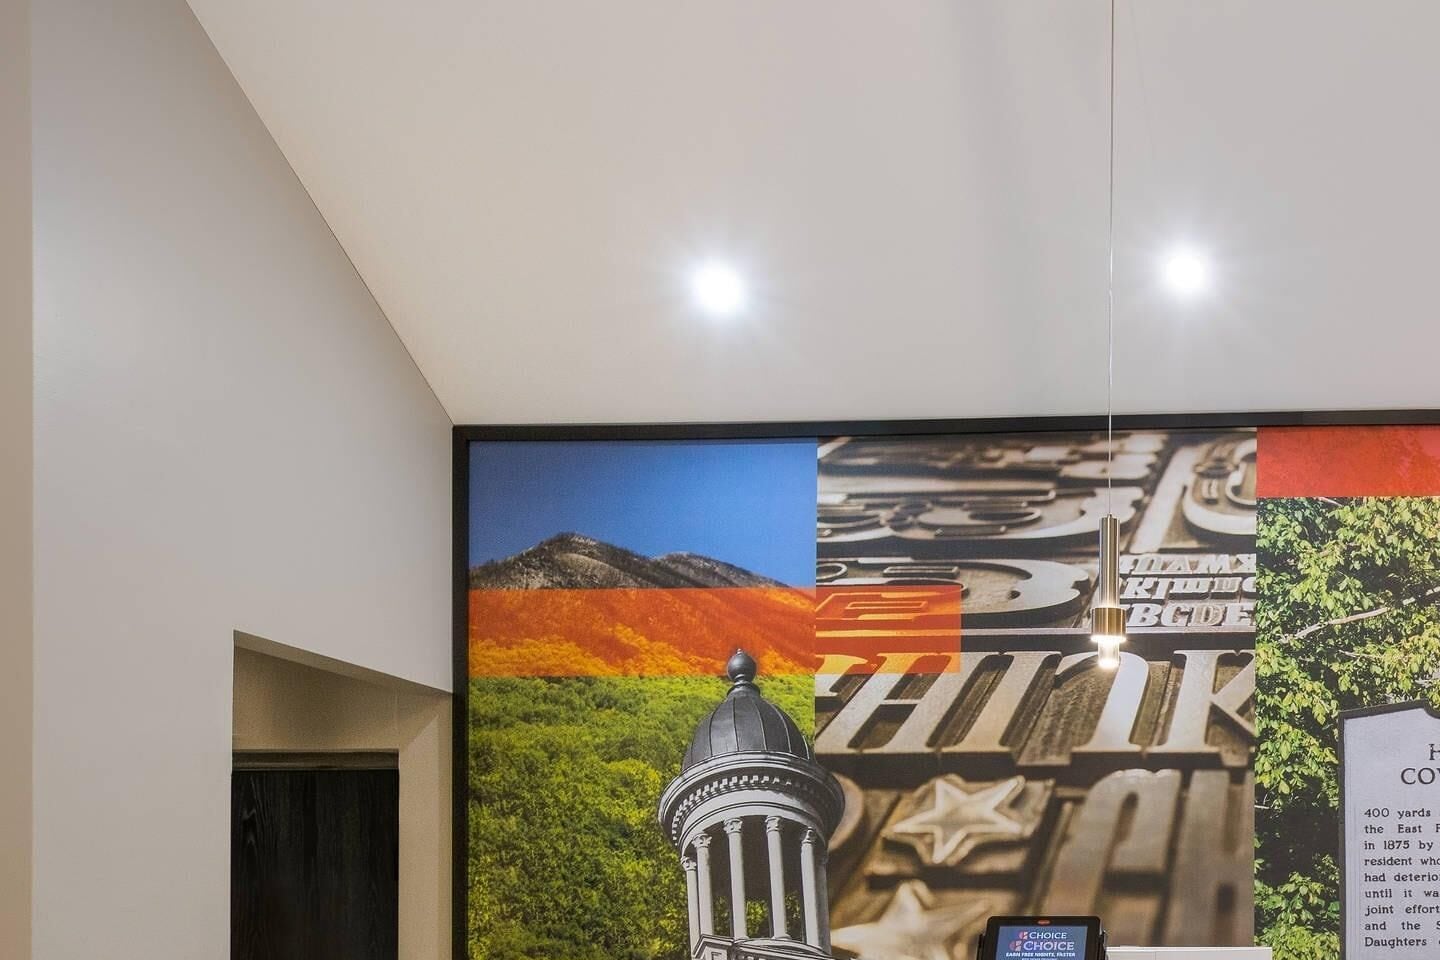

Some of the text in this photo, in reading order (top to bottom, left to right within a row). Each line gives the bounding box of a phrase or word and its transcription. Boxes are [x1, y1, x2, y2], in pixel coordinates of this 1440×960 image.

[1364, 807, 1389, 818] 400
[1397, 807, 1430, 819] yards
[1364, 824, 1384, 834] the
[1398, 823, 1422, 833] East
[1364, 840, 1375, 850] in
[1384, 839, 1409, 850] 1875
[1419, 839, 1433, 851] by
[1364, 856, 1412, 866] resident
[1364, 872, 1386, 882] had
[1365, 888, 1392, 898] until
[1404, 888, 1412, 897] it
[1365, 904, 1393, 916] joint
[1365, 920, 1386, 930] and
[1401, 920, 1421, 930] the
[1029, 931, 1067, 939] CHOICE
[1023, 940, 1075, 951] CHOICE
[1365, 936, 1427, 948] Daughters
